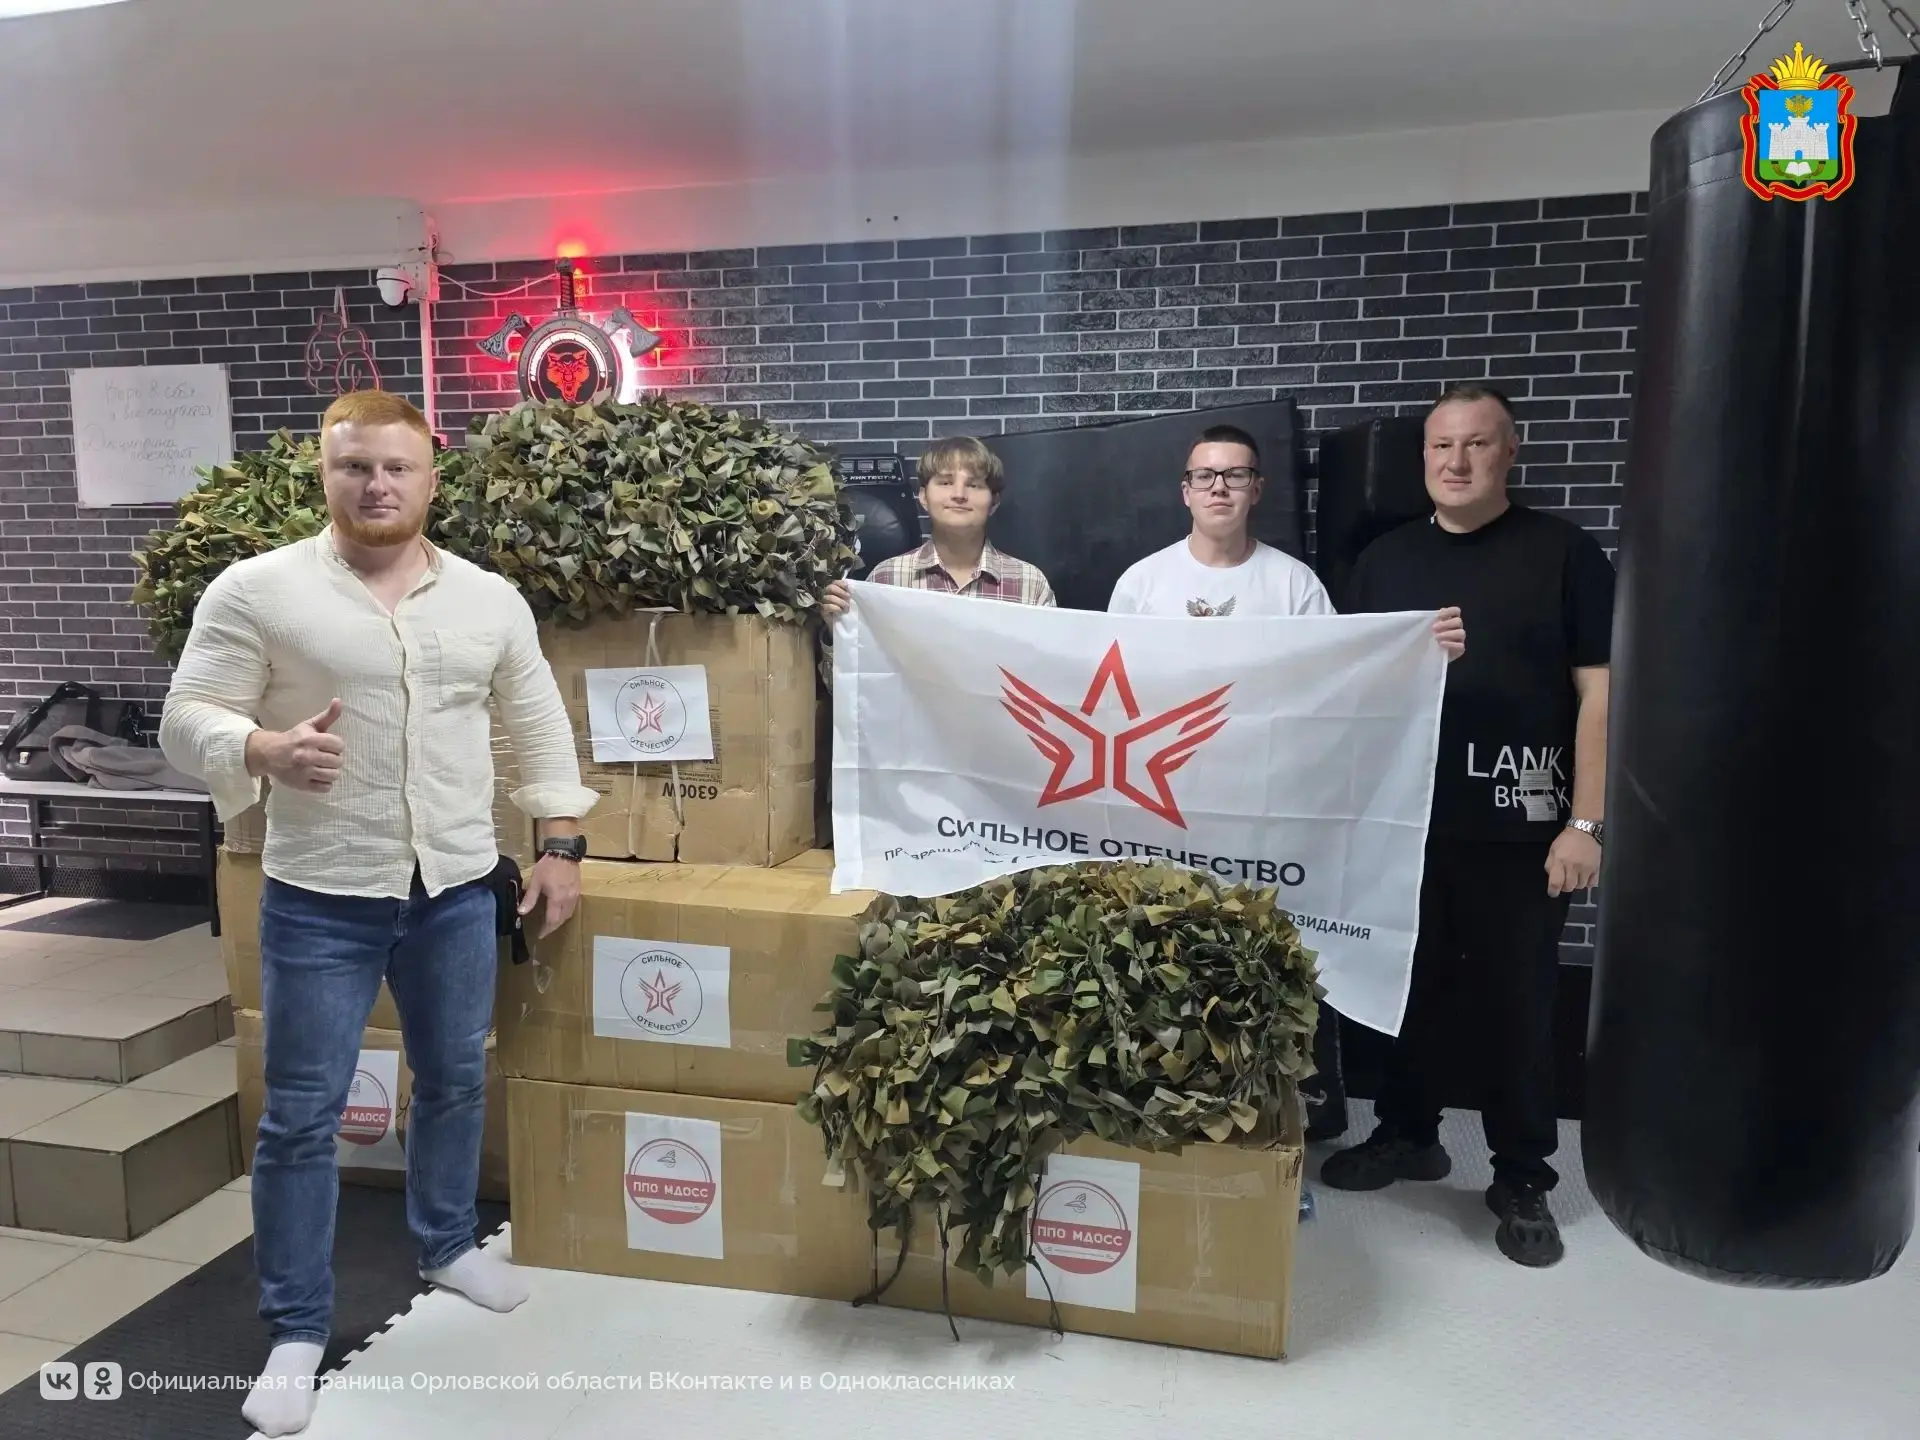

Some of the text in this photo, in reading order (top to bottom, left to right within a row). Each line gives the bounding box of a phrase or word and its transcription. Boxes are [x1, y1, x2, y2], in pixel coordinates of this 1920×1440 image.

[630, 680, 665, 690] СИЛЬНОЕ
[630, 735, 675, 749] ОТЕЧЕСТВО
[937, 816, 1306, 887] СИЛЬНОЕ ОТЕЧЕСТВО
[641, 954, 683, 968] СИЛЬНОЕ
[637, 1015, 688, 1031] ОТЕЧЕСТВО
[351, 1111, 386, 1122] МДОСС
[633, 1181, 708, 1198] ППО МДОСС
[1037, 1225, 1123, 1246] ППО МДОСС
